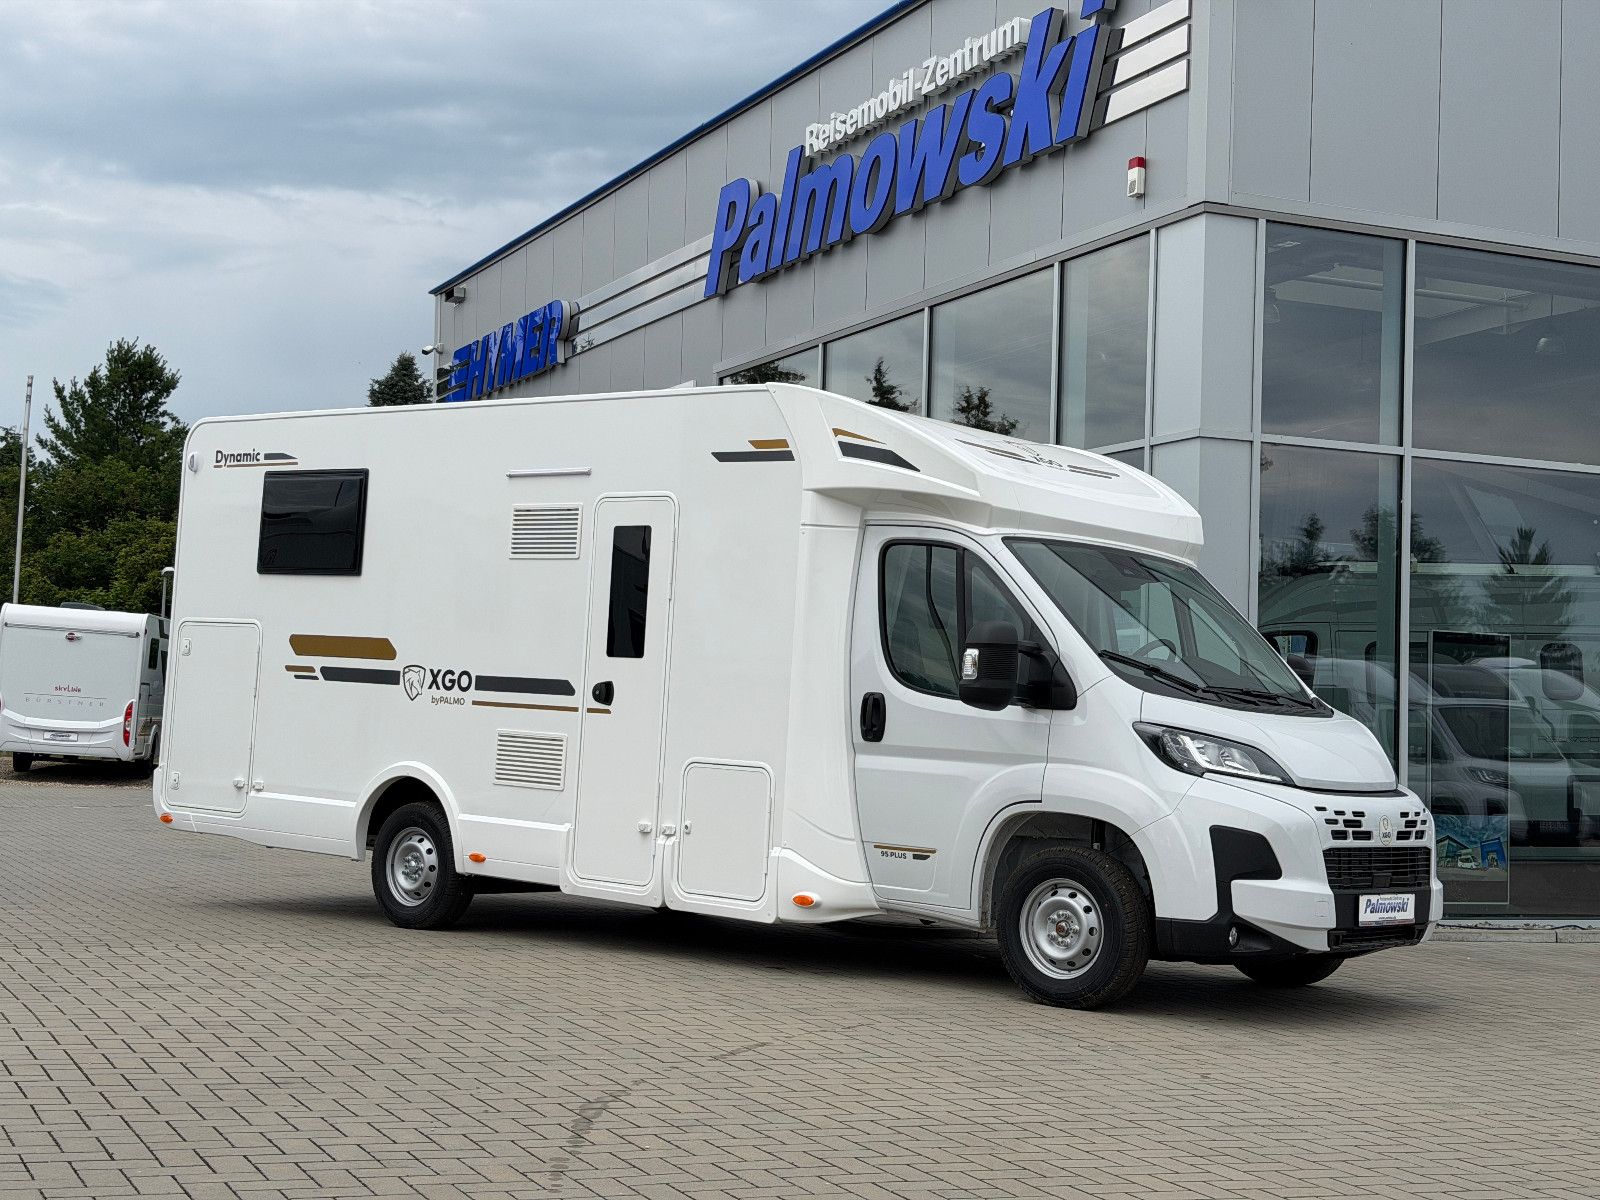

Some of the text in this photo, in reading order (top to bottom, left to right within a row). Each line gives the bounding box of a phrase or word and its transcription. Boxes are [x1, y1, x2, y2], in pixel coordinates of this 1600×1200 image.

[804, 16, 1030, 156] Reisemobil-Zentrum
[704, 0, 1108, 299] Palmowski
[448, 299, 565, 402] HYMER
[215, 448, 261, 467] Dynamic
[427, 668, 473, 692] XGO
[880, 850, 907, 860] 95 PLUS
[1364, 897, 1410, 914] Palmowski
